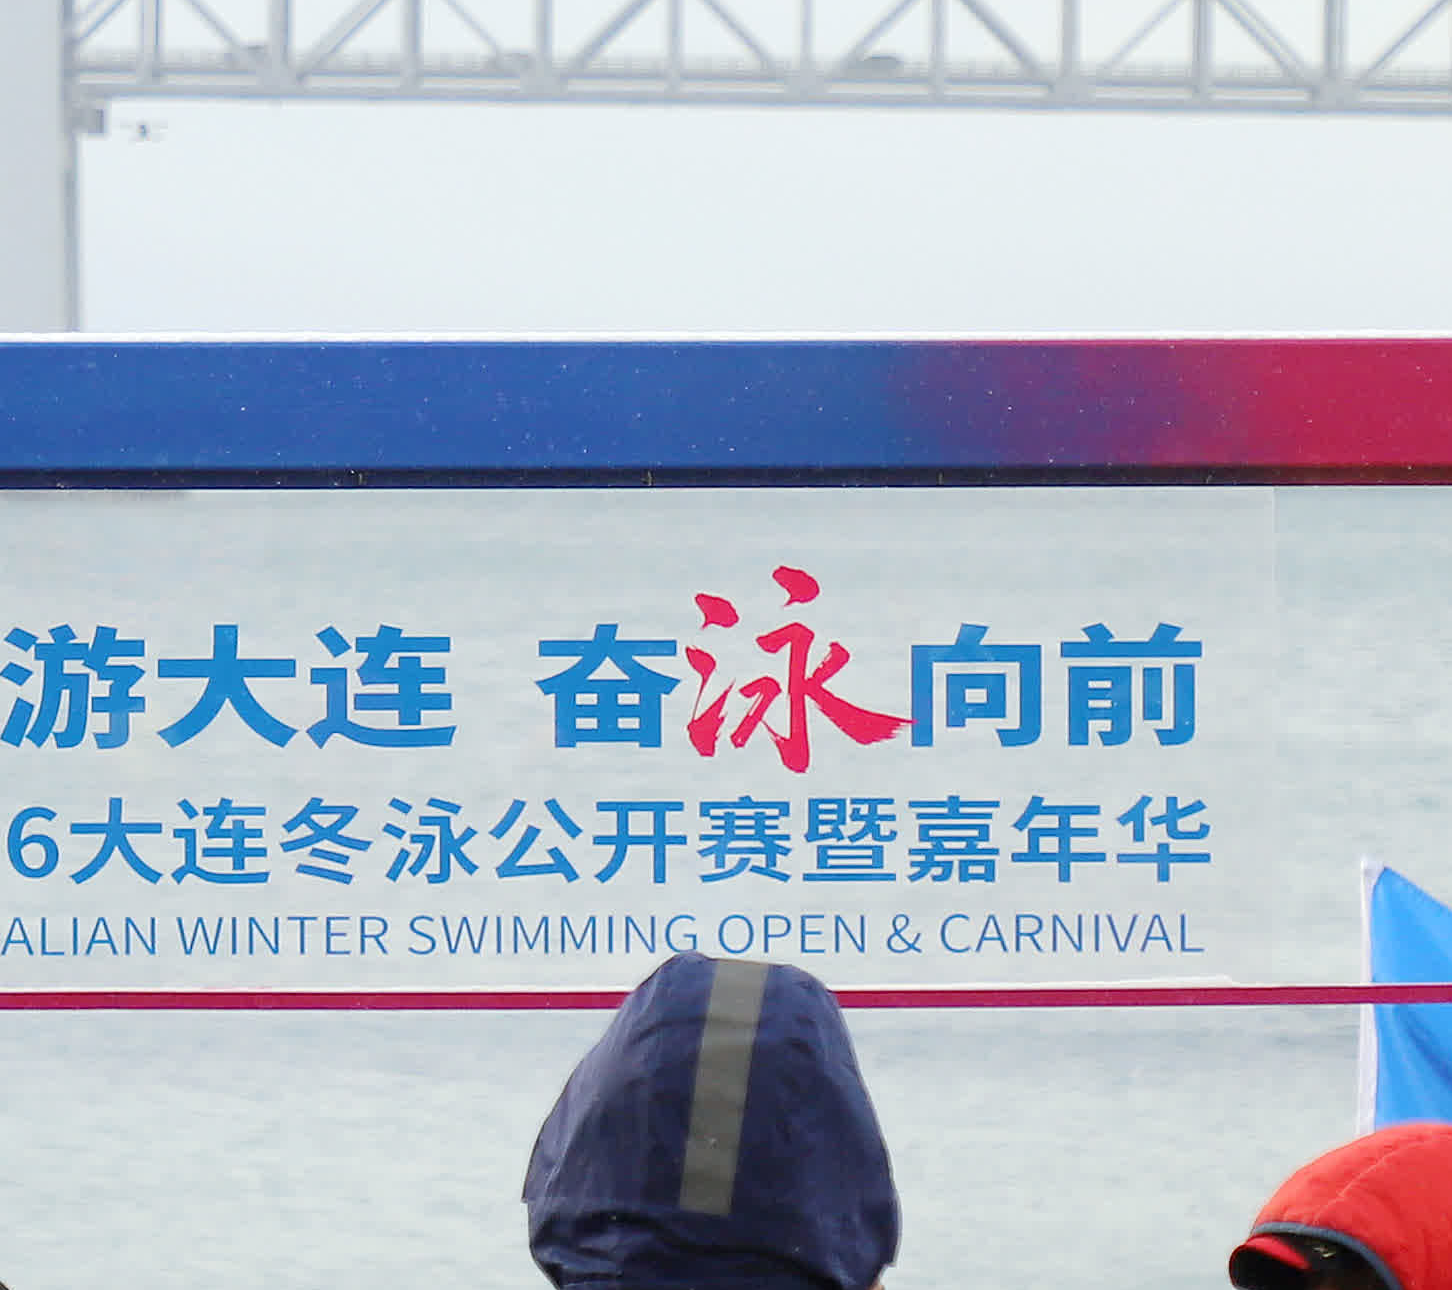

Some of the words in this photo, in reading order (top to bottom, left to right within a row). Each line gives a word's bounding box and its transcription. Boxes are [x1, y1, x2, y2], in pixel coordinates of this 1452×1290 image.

[535, 565, 1205, 774] 奋泳向前
[176, 915, 390, 958] WINTER
[406, 913, 698, 956] SWIMMING
[717, 913, 867, 957] OPEN
[885, 913, 923, 955] &
[939, 910, 1206, 957] CARNIVAL
